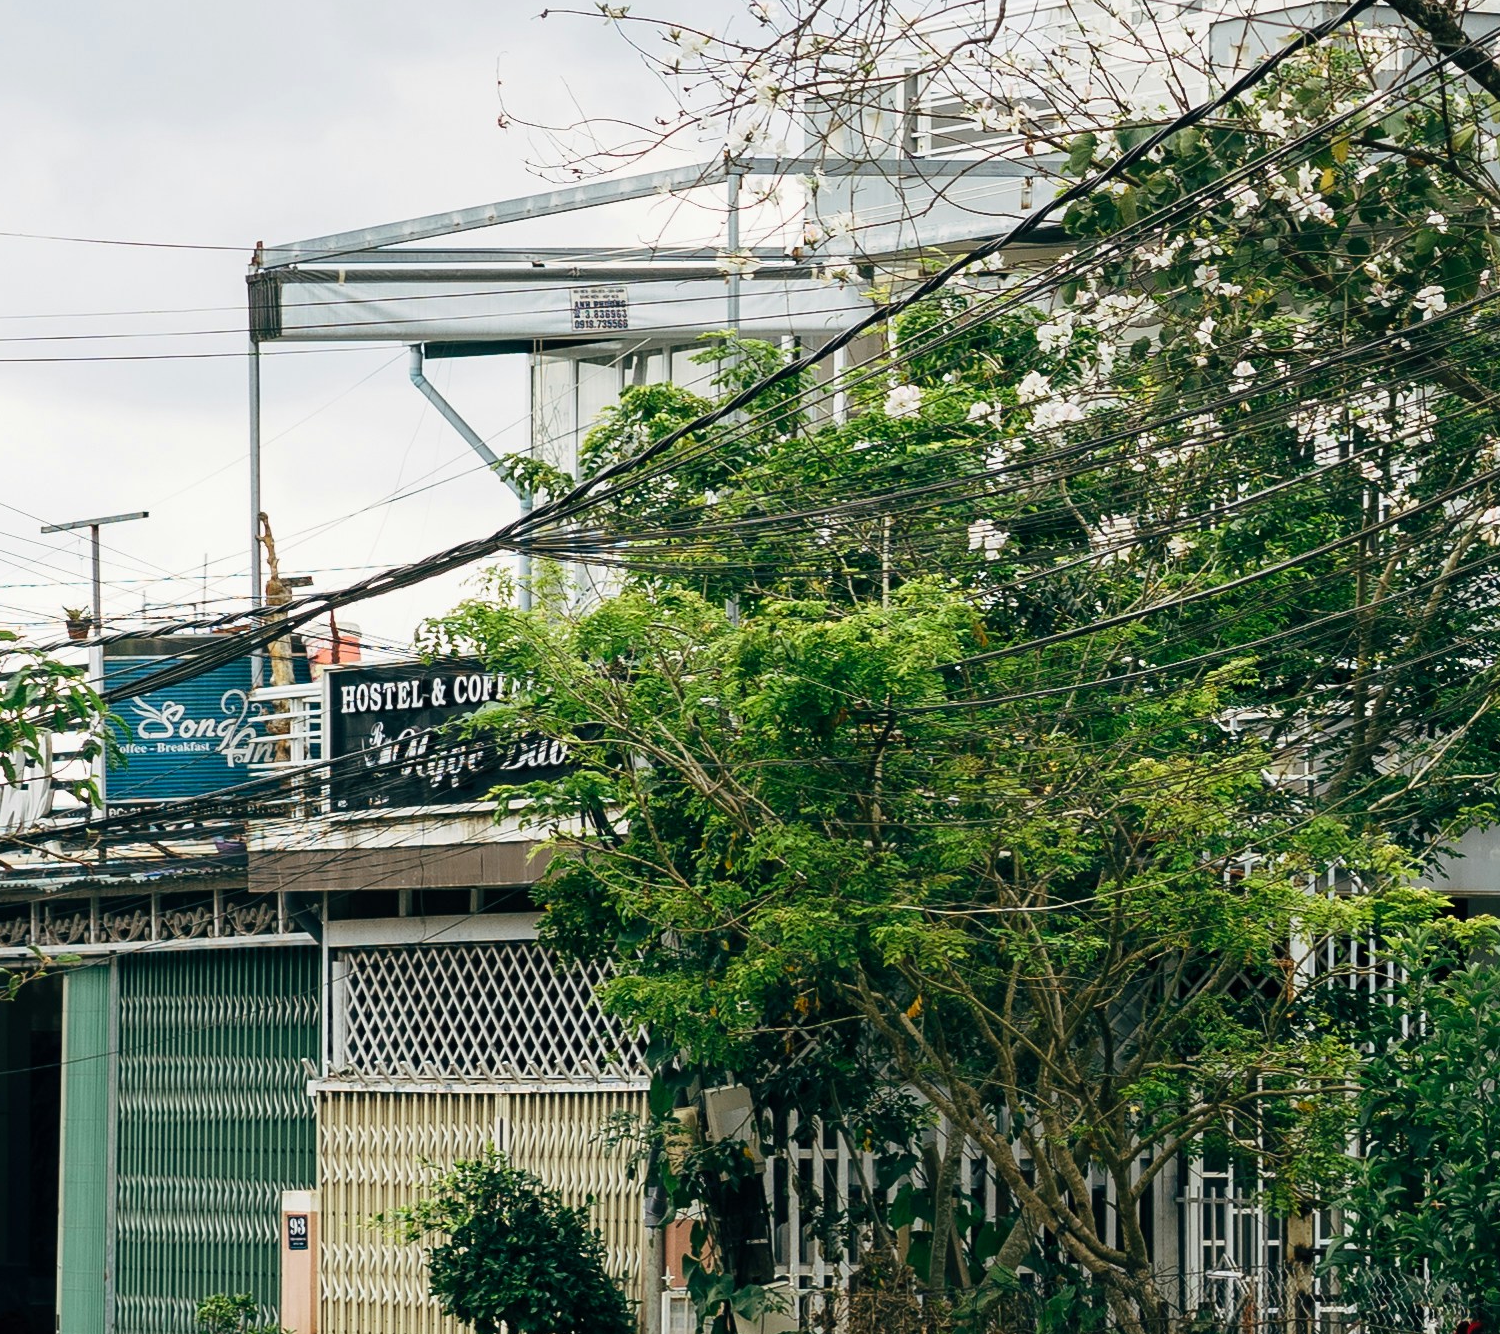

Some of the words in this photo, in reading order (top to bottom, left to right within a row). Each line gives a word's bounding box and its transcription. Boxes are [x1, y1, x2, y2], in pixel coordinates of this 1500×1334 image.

[340, 680, 424, 714] HOSTEL
[431, 677, 447, 707] &
[157, 742, 210, 754] Breakfast
[289, 1217, 306, 1236] 93
